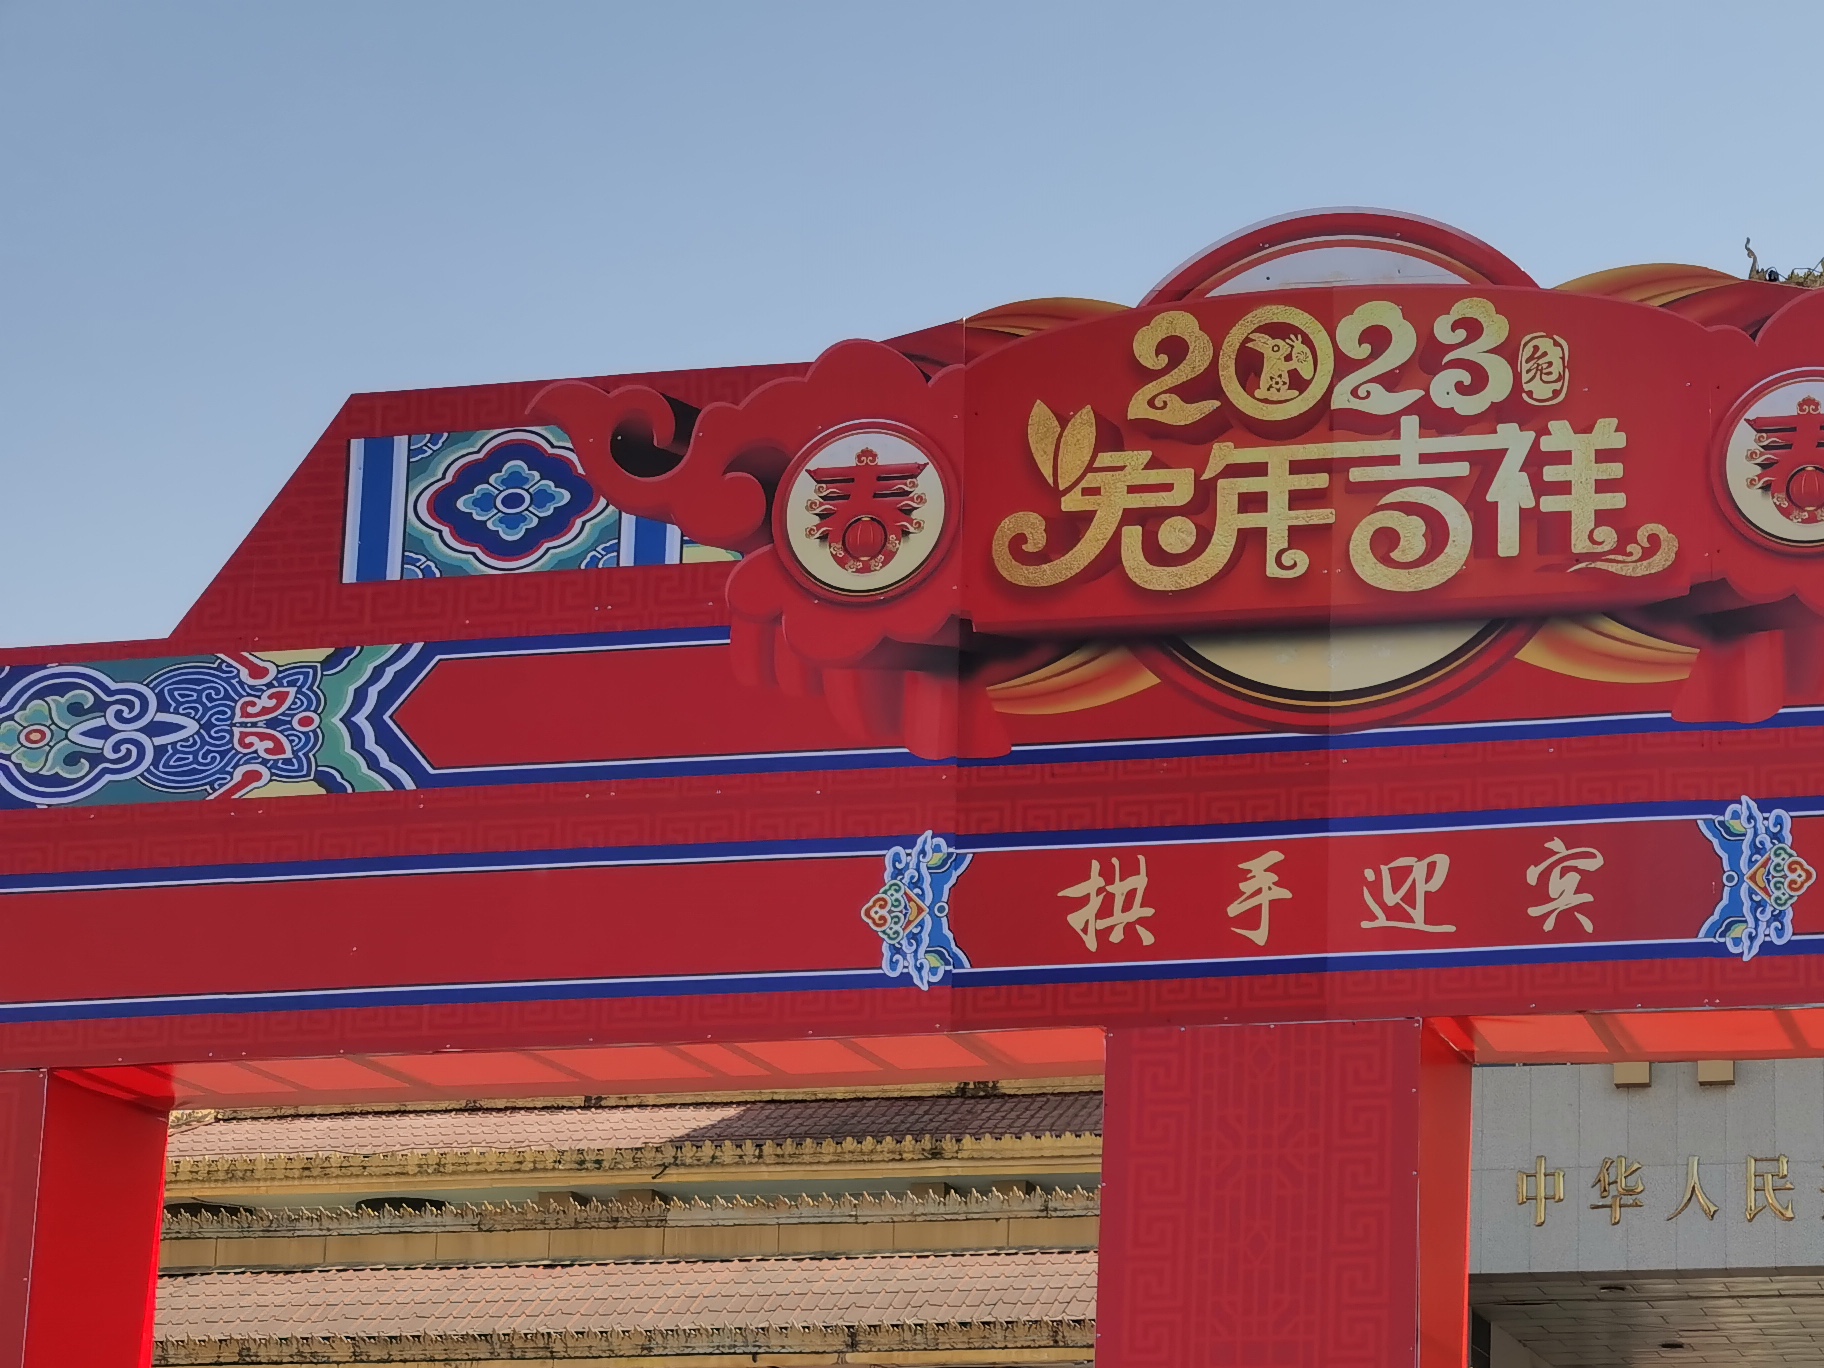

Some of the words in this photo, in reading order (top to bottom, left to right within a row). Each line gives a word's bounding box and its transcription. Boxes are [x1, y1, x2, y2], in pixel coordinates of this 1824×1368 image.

[1127, 297, 1514, 425] 2023
[805, 447, 929, 574] 春
[991, 400, 1679, 593] 兔年吉祥
[1056, 836, 1605, 950] 拱手迎宾
